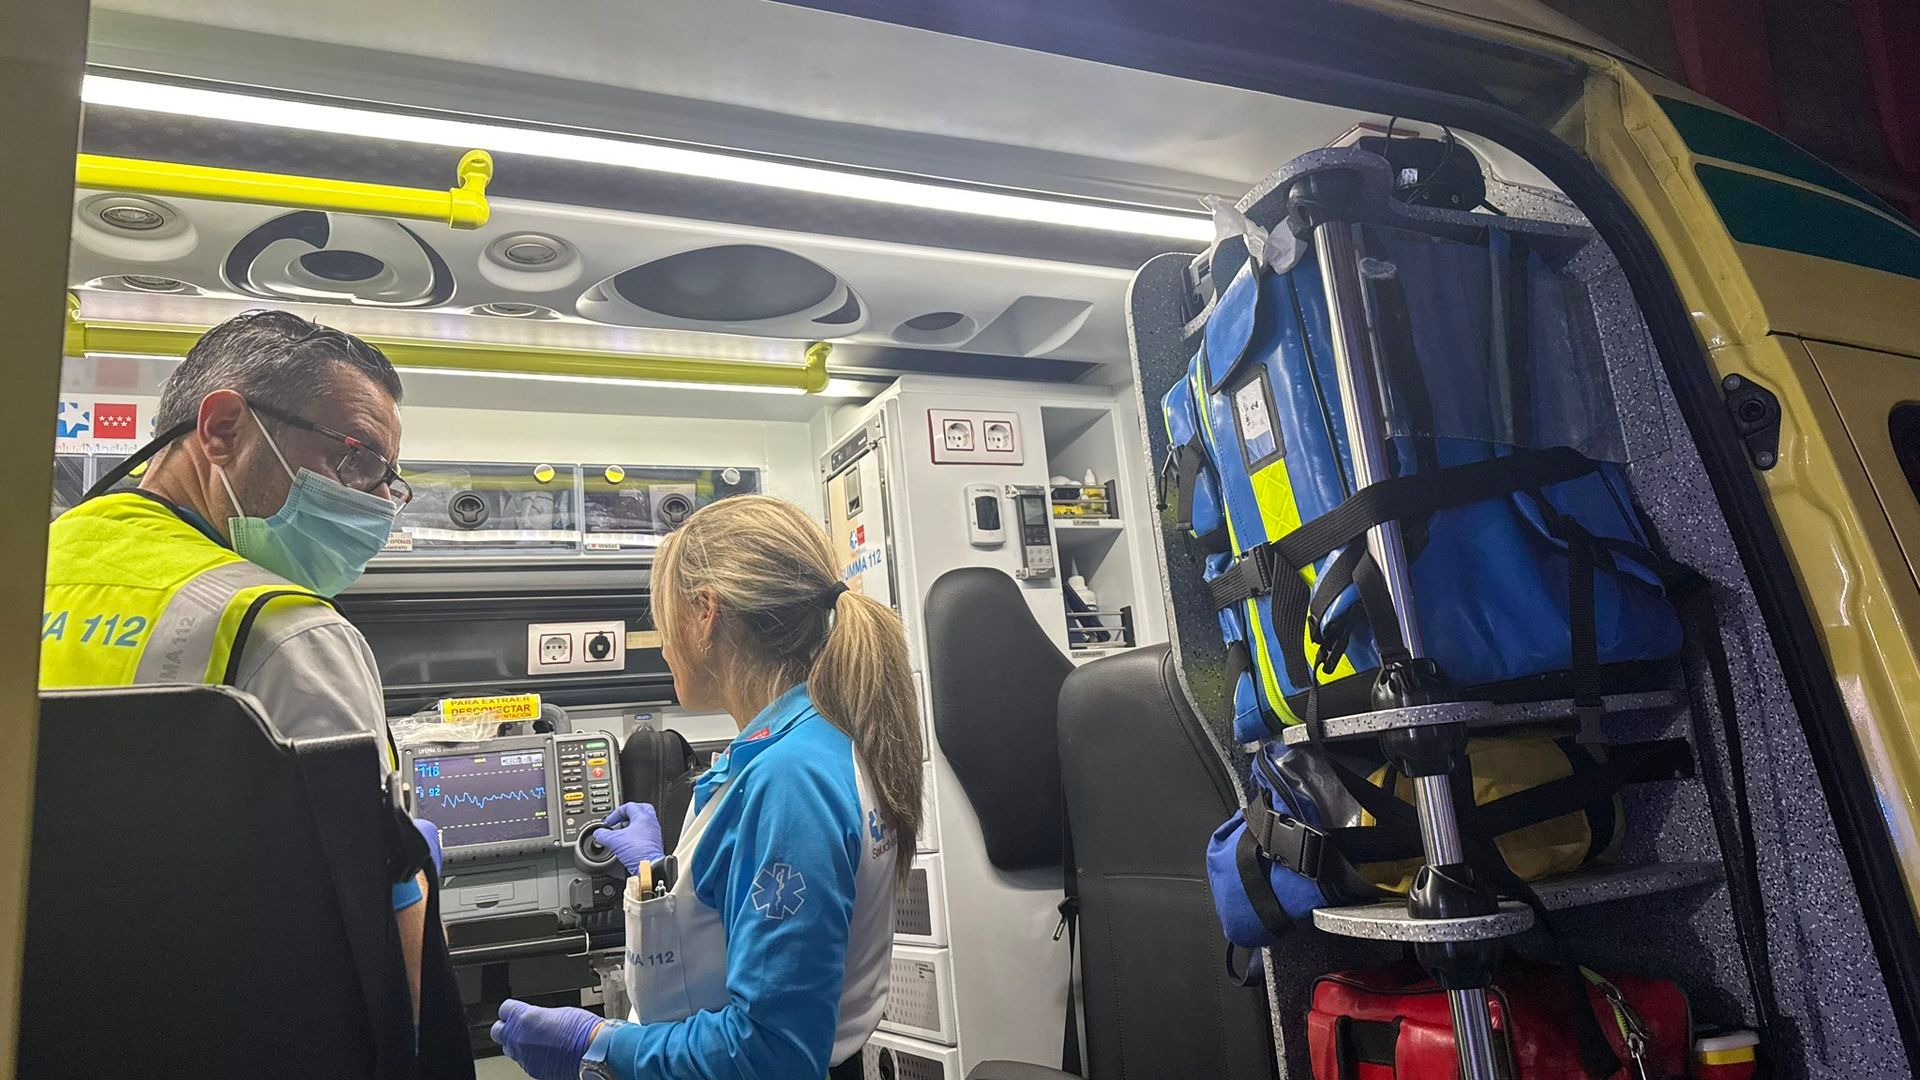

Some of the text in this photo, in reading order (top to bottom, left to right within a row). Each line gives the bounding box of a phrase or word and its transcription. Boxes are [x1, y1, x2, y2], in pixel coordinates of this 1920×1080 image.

[869, 548, 882, 567] 112
[80, 613, 147, 648] 112
[172, 615, 197, 645] 112
[451, 696, 530, 707] PARA EXTRAER
[451, 703, 531, 717] DESCONECTAR
[419, 765, 440, 777] 118
[428, 787, 441, 797] 92
[648, 950, 675, 966] 112
